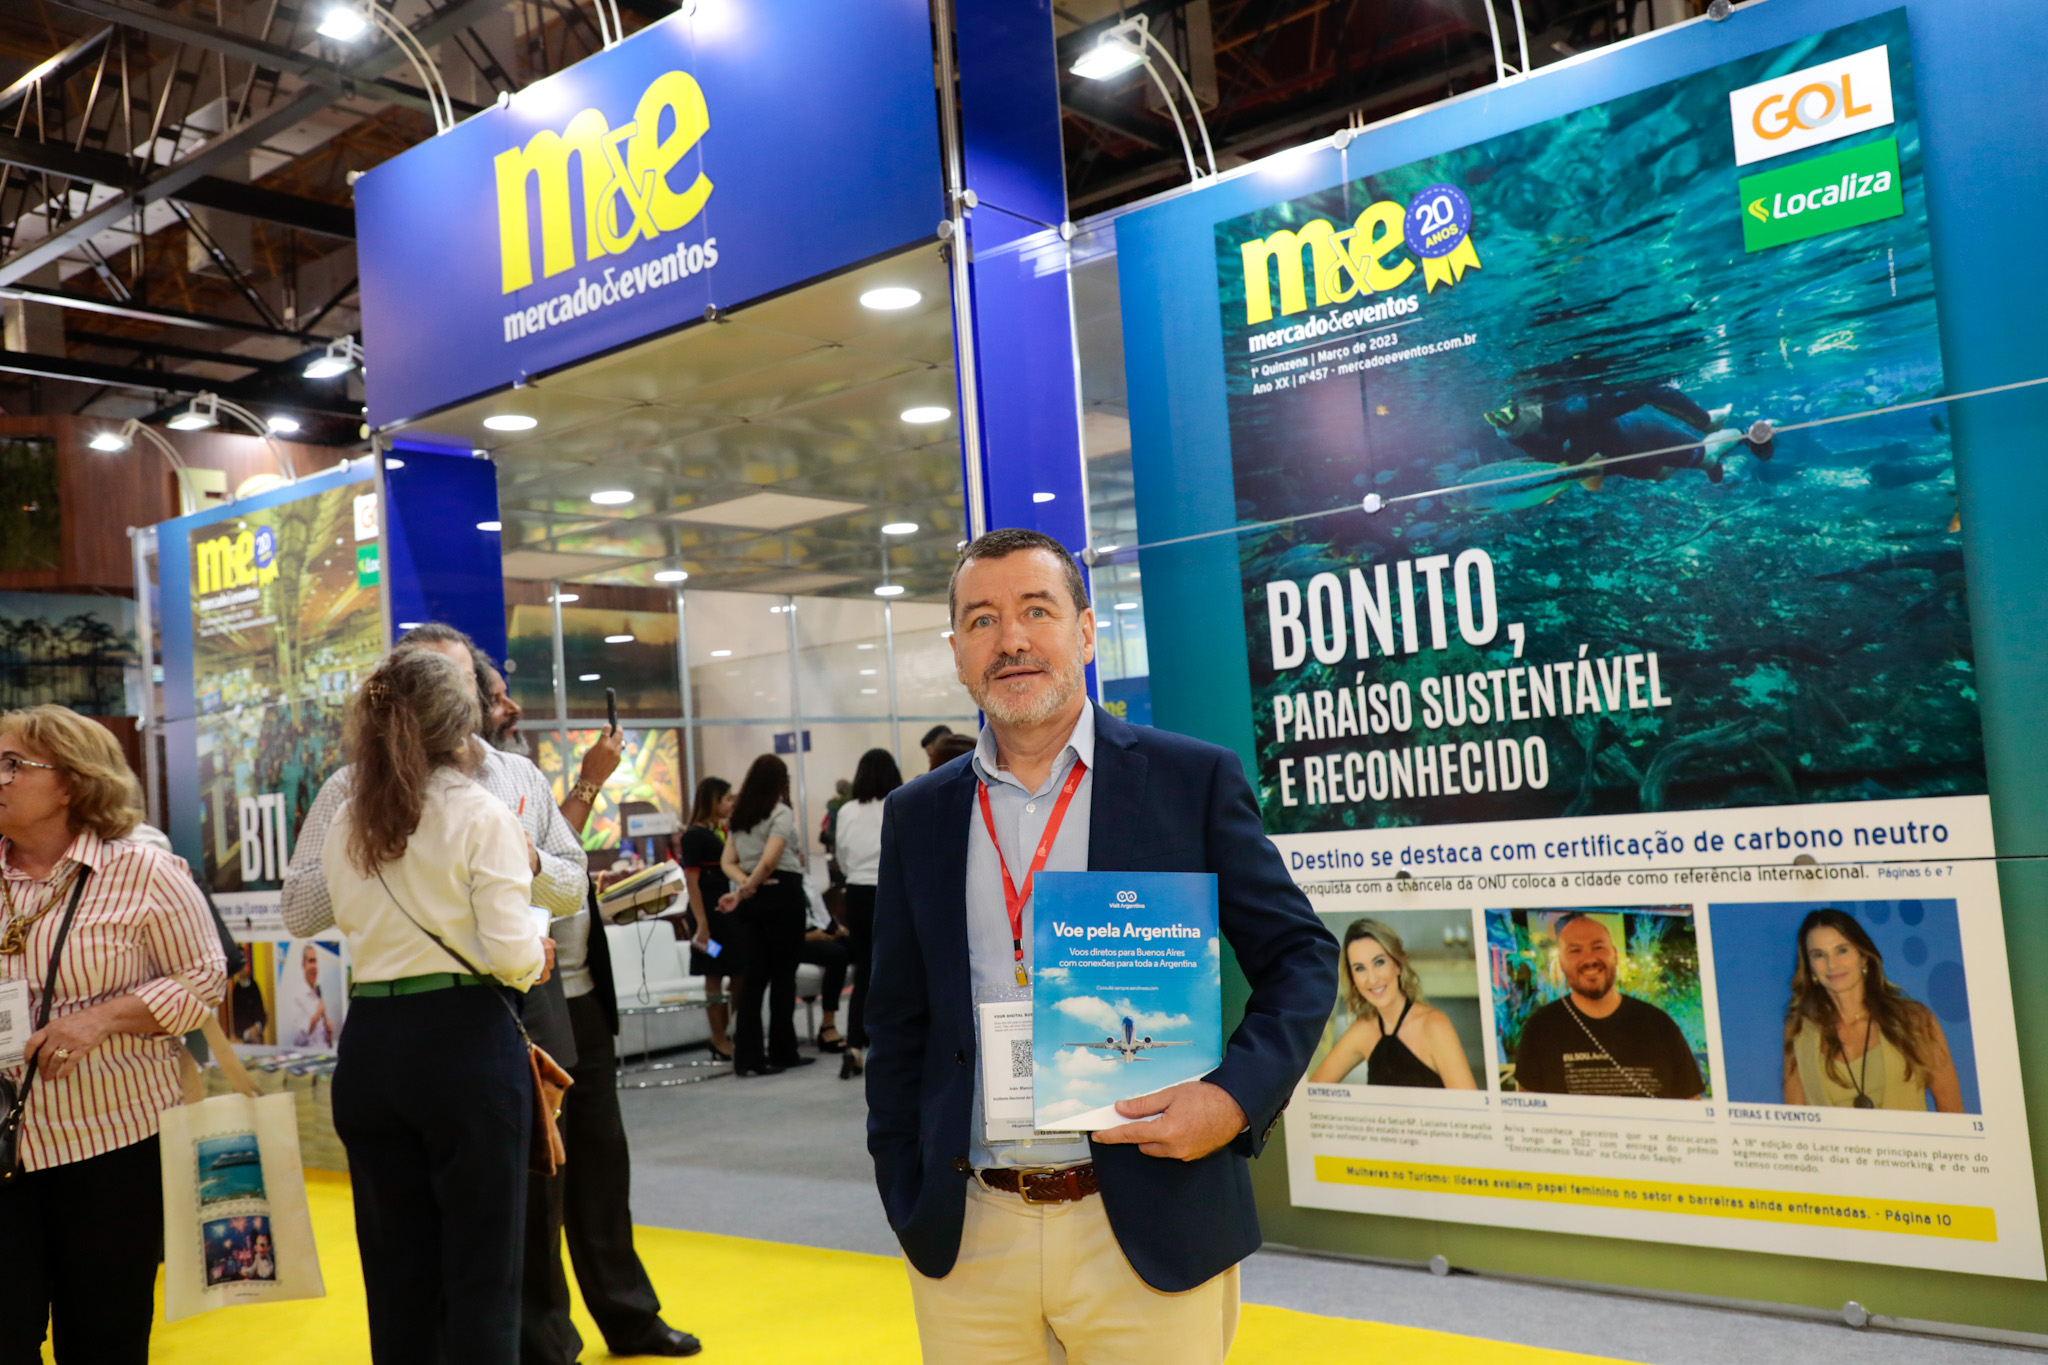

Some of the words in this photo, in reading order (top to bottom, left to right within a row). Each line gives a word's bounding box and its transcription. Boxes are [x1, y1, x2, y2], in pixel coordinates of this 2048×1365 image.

[1752, 73, 1872, 140] GOL
[494, 70, 714, 295] m&e
[1772, 170, 1892, 219] Localiza
[1416, 195, 1454, 236] 20
[1425, 223, 1458, 248] ANOS
[1241, 200, 1416, 325] m&e
[504, 237, 718, 342] mercado&eventos
[1249, 294, 1419, 352] mercado&eventos
[1252, 382, 1273, 395] Ano
[1275, 376, 1290, 390] XX
[1338, 333, 1477, 376] mercadoeeventos.com.br
[1261, 356, 1308, 376] Quinzena
[1318, 347, 1350, 364] Março
[1352, 342, 1366, 355] de
[1370, 334, 1398, 350] 2023
[1266, 548, 1526, 671] BONITO,
[1273, 670, 1413, 743] PARAÍSO
[1420, 644, 1672, 730] SUSTENTÁVEL
[1279, 758, 1298, 807] E
[1304, 736, 1549, 806] RECONHECIDO
[1291, 849, 1364, 870] Destino
[1371, 850, 1392, 867] se
[1400, 844, 1482, 865] destaca
[1490, 843, 1536, 860] com
[1544, 830, 1685, 860] certificação
[1694, 830, 1724, 852] de
[1734, 827, 1843, 851] carbono
[1854, 821, 1949, 847] neutro
[1296, 881, 1351, 898] onquista
[1356, 882, 1382, 894] com
[1386, 883, 1393, 892] a
[1397, 877, 1452, 892] chancela
[1457, 876, 1473, 891] da
[1478, 874, 1507, 890] ONU
[1512, 872, 1556, 889] coloca
[1561, 876, 1569, 887] a
[1574, 870, 1621, 888] cidade
[1627, 873, 1668, 885] como
[1674, 864, 1752, 884] referência
[1758, 863, 1869, 882] internacional.
[1878, 867, 1921, 880] Páginas
[1925, 866, 1933, 877] 6
[1935, 868, 1942, 877] e
[1946, 866, 1953, 876] 7
[1053, 922, 1083, 937] Voe
[1087, 922, 1120, 941] pela
[1123, 922, 1201, 941] Argentina
[1069, 947, 1089, 956] Voos
[1090, 948, 1116, 956] diretos
[1118, 950, 1135, 959] para
[1136, 948, 1165, 956] Buenos
[1166, 948, 1185, 956] Aires
[1078, 959, 1115, 967] conexões
[1117, 960, 1134, 969] para
[1135, 959, 1152, 967] toda
[1160, 959, 1197, 969] Argentina
[1307, 1088, 1351, 1098] ENTREVISTA
[1501, 1098, 1547, 1108] HOTELARIA
[1729, 1108, 1762, 1120] FEIRAS
[1765, 1110, 1771, 1120] E
[1774, 1111, 1821, 1122] EVENTOS
[1973, 1122, 1984, 1132] 13
[1733, 1138, 1739, 1146] A
[1761, 1140, 1793, 1151] edição
[1796, 1141, 1809, 1150] do
[1876, 1146, 1928, 1158] principais
[1932, 1149, 1969, 1162] players
[1974, 1152, 1988, 1162] do
[1804, 1152, 1824, 1162] dois
[1830, 1154, 1850, 1164] dias
[1855, 1156, 1868, 1166] de
[1874, 1158, 1934, 1172] networking
[1952, 1163, 1966, 1172] de
[1973, 1165, 1989, 1174] um
[1347, 1166, 1389, 1179] Mulheres
[1392, 1170, 1404, 1180] no
[1408, 1171, 1450, 1184] Turismo:
[1454, 1174, 1489, 1188] líderes
[1494, 1178, 1533, 1191] avaliam
[1537, 1180, 1567, 1195] papel
[1571, 1183, 1619, 1199] feminino
[1624, 1188, 1638, 1200] no
[1642, 1189, 1672, 1203] setor
[1677, 1194, 1684, 1203] e
[1689, 1194, 1744, 1209] barreiras
[1750, 1197, 1783, 1212] ainda
[1788, 1200, 1871, 1220] enfrentadas.
[1885, 1209, 1932, 1226] Página
[1936, 1213, 1952, 1226] 10
